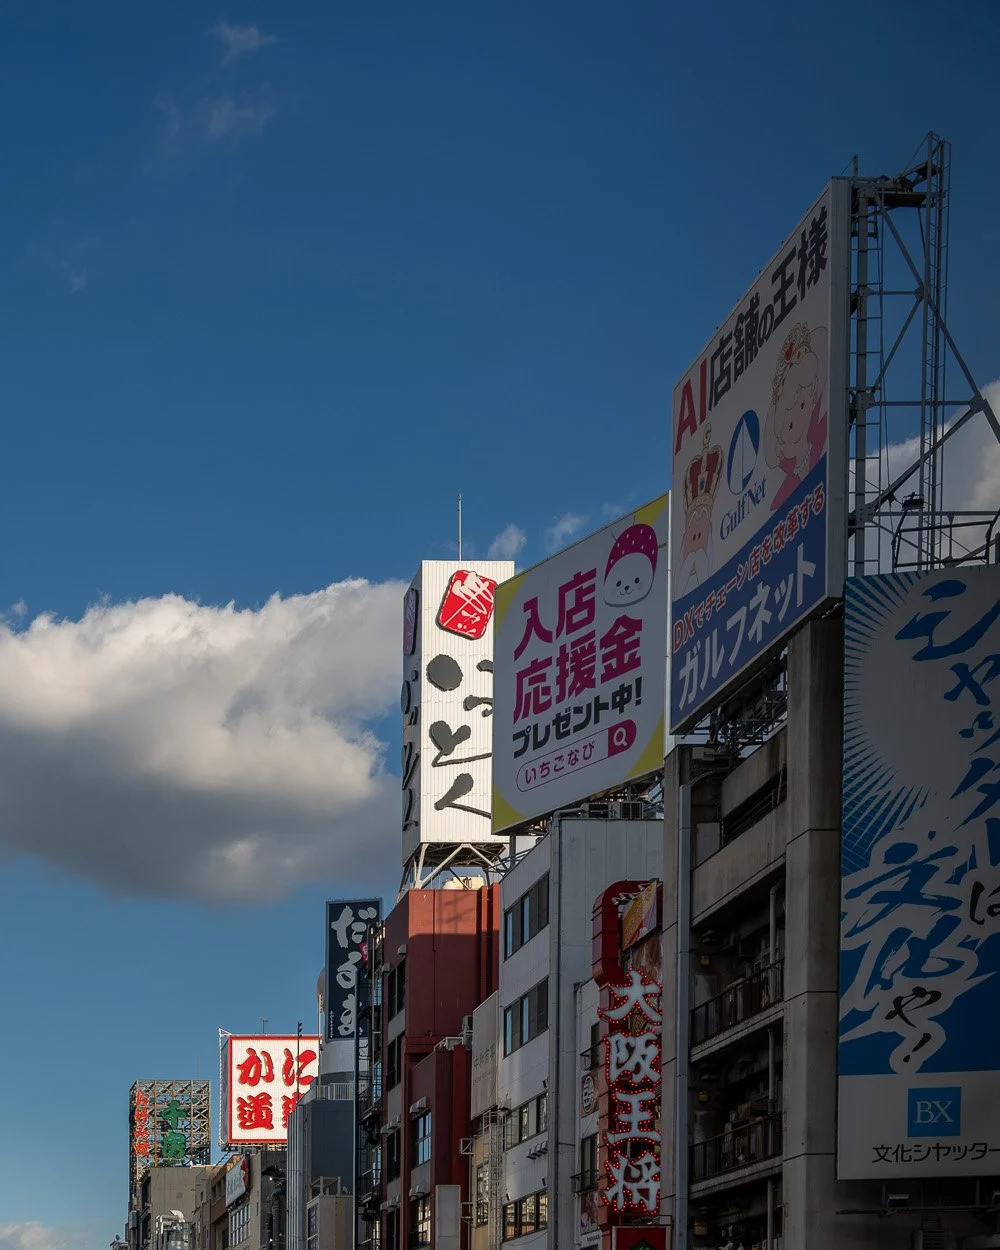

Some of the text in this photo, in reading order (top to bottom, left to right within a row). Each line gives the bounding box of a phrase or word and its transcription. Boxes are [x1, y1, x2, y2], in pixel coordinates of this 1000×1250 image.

[674, 205, 828, 456] AI店舗の王様
[513, 567, 598, 662] 入店
[673, 481, 825, 655] DXでチェーン店を改革する
[512, 614, 643, 725] 応援金
[678, 542, 817, 711] ガルフネット
[524, 740, 596, 785] いちごなび
[237, 1047, 317, 1087] かに
[598, 966, 663, 1216] 大阪王将
[914, 1100, 954, 1124] BX
